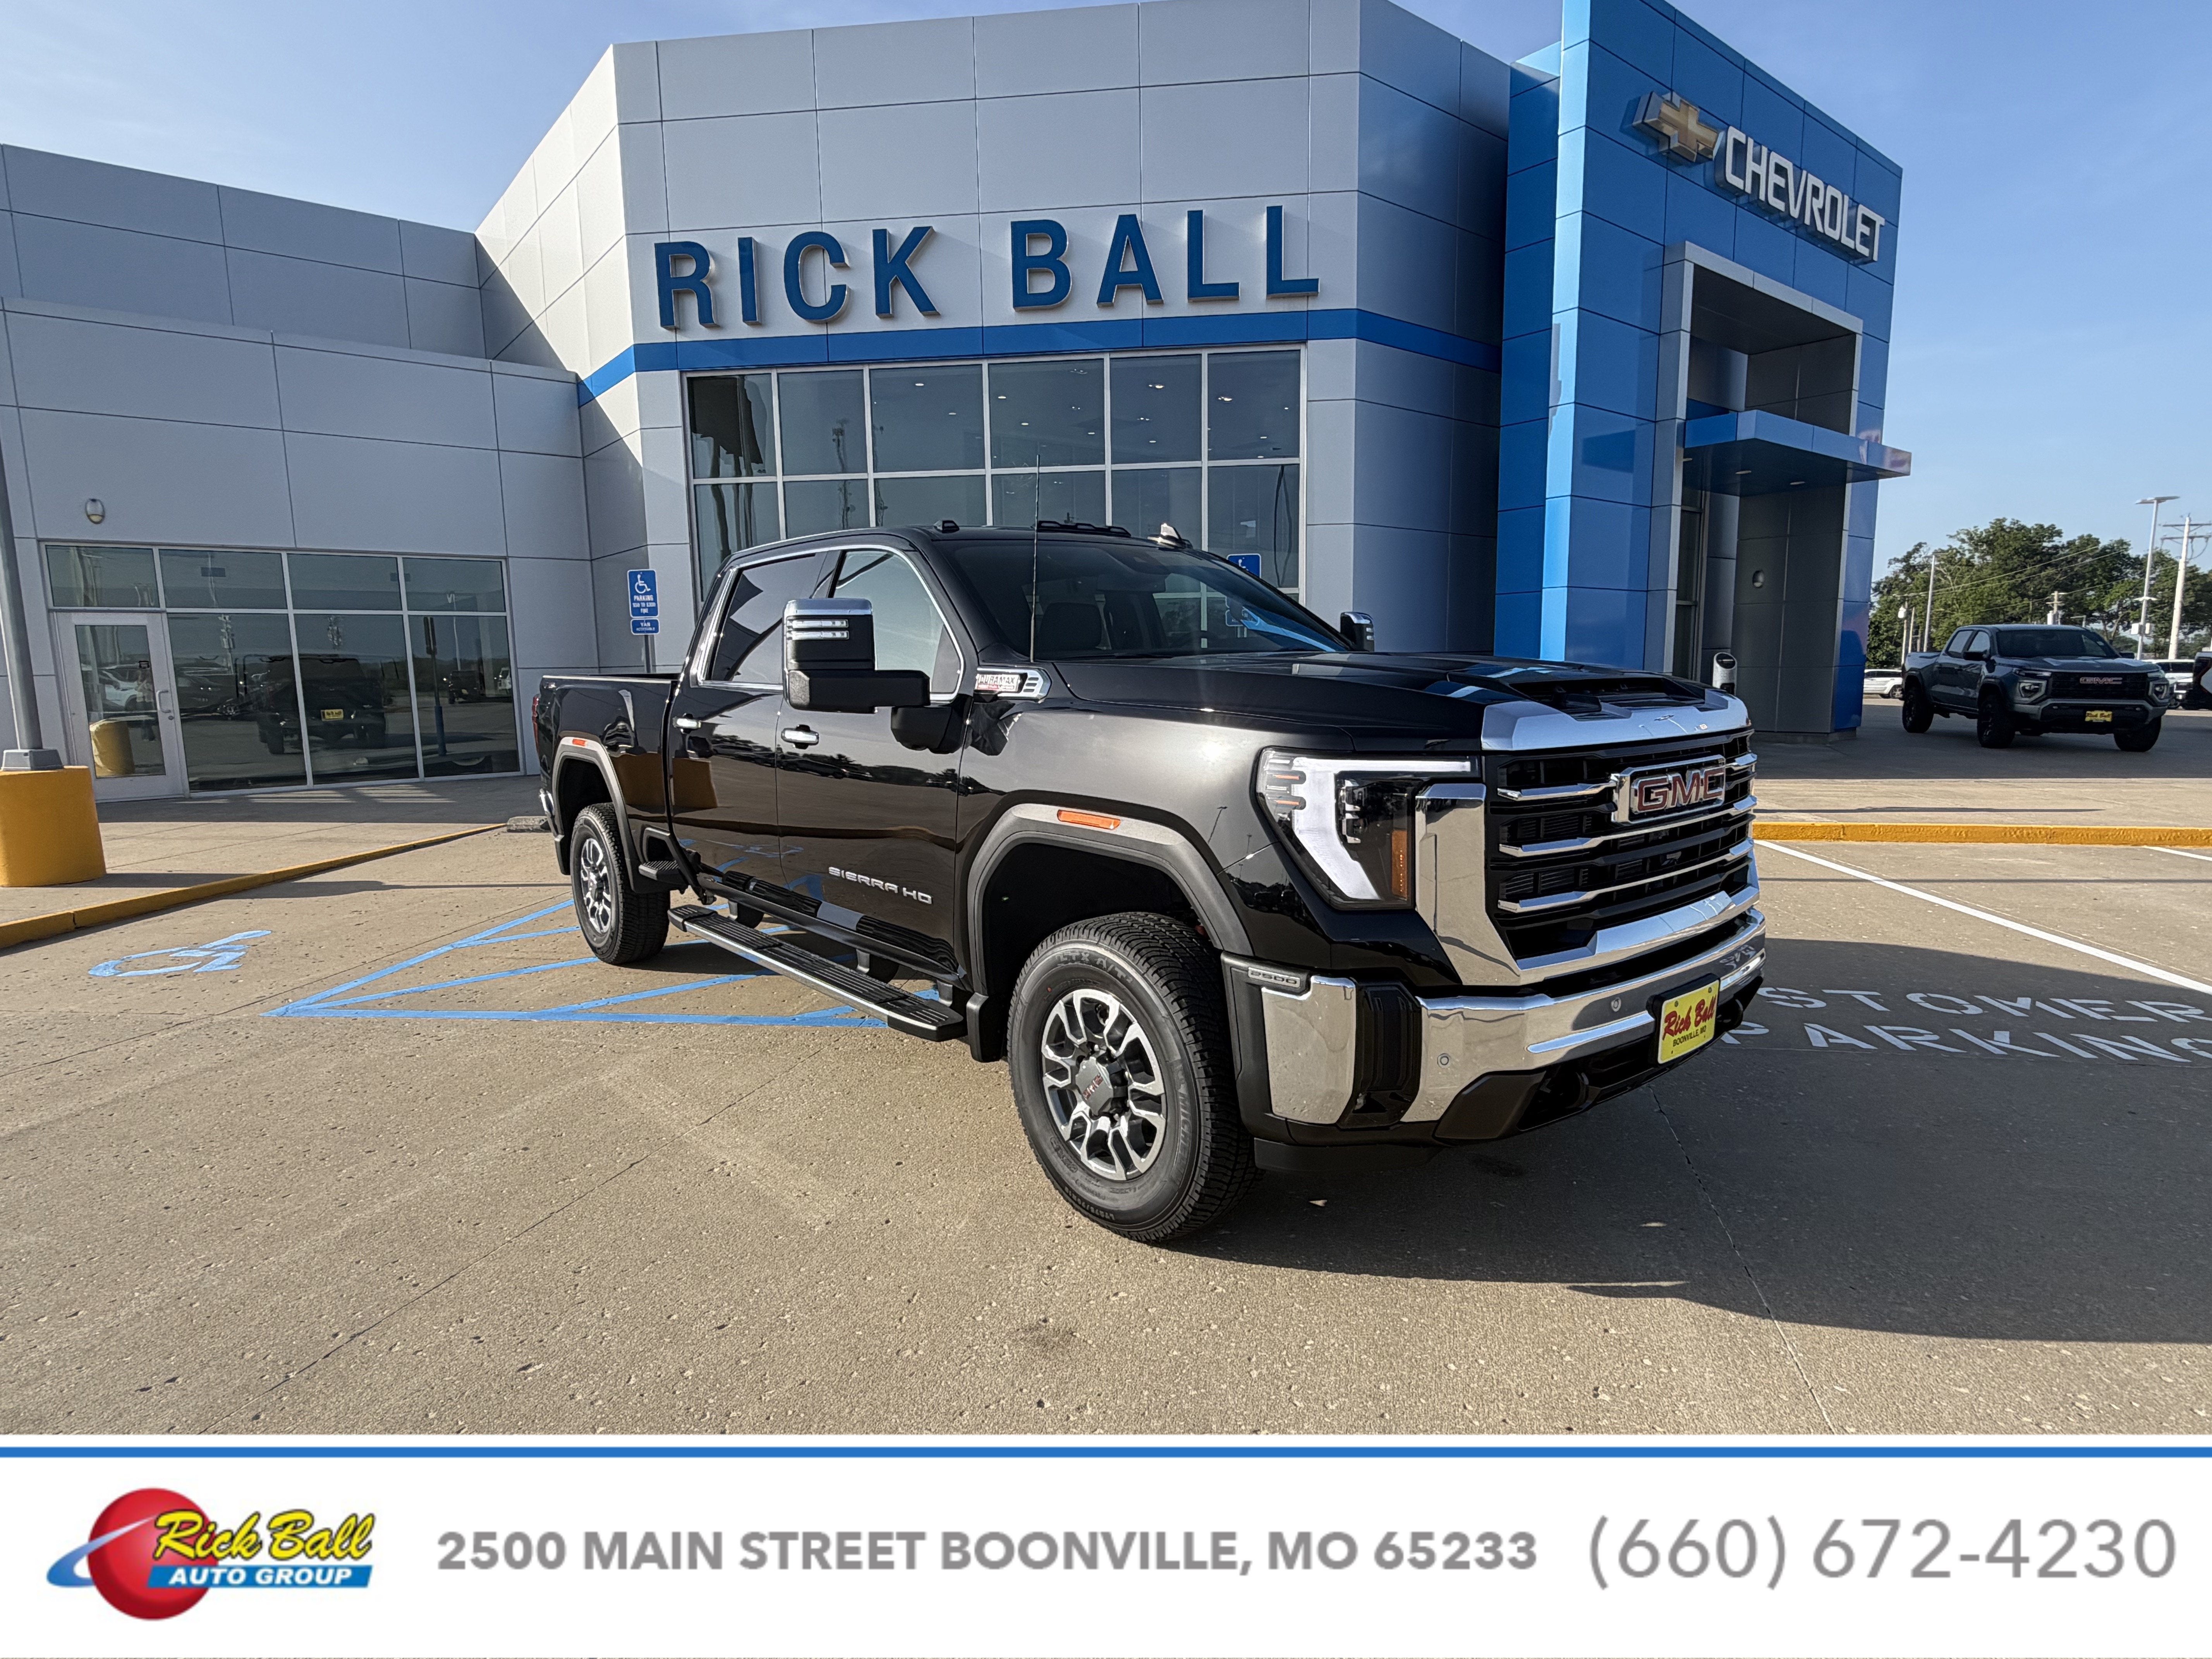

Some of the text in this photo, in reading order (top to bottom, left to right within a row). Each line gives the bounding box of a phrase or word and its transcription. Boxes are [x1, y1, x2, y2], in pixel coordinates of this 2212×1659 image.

[1723, 125, 1886, 263] CHEVROLET
[654, 205, 1320, 330] RICK BALL
[977, 675, 1015, 684] DURAMAX
[1633, 767, 1725, 814] GMC
[828, 866, 932, 905] SIERRA HD
[1662, 994, 1717, 1041] Rick Ball
[1700, 1025, 1707, 1035] MO
